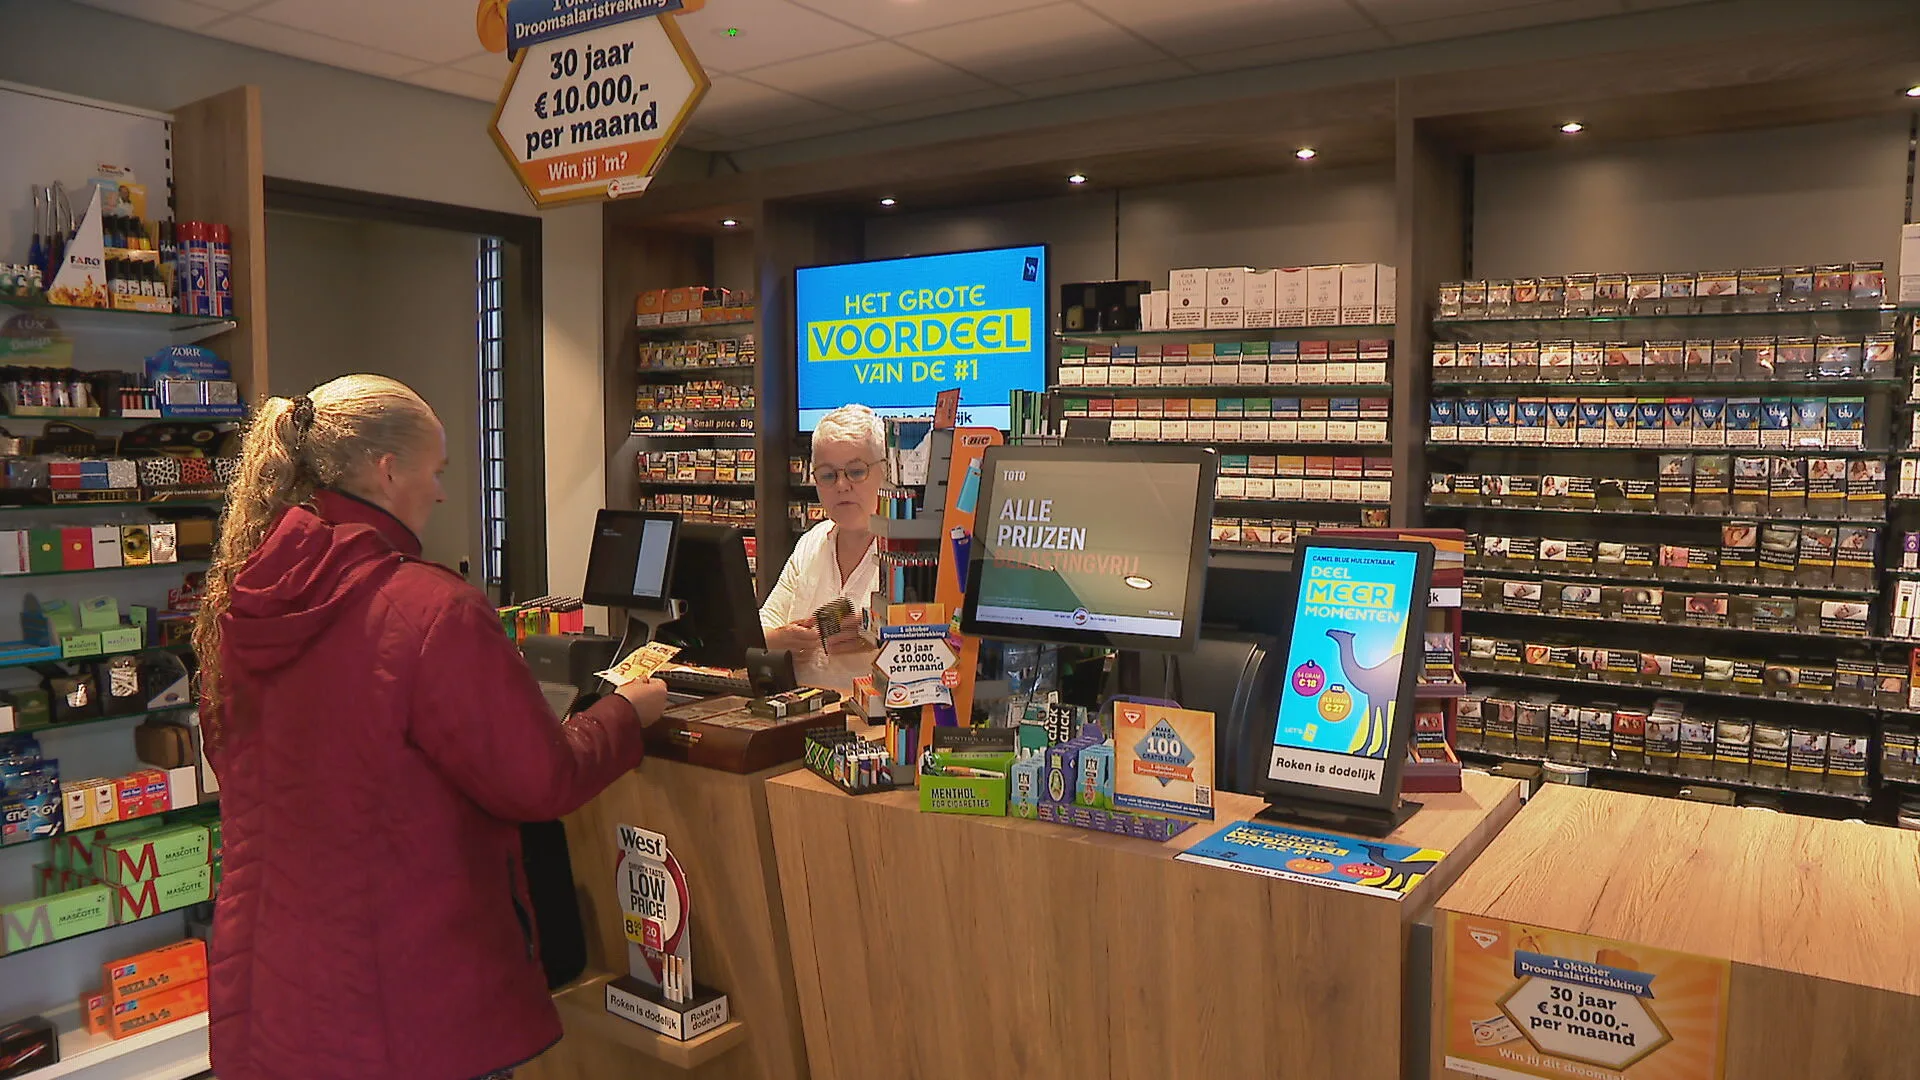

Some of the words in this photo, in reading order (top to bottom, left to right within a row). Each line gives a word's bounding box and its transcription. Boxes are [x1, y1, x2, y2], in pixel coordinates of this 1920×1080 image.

[550, 49, 578, 80] 30
[583, 41, 634, 80] jaar
[526, 126, 563, 160] per
[571, 101, 658, 145] maand
[548, 161, 578, 181] Win
[580, 156, 597, 181] jij
[70, 255, 100, 265] FARO
[844, 292, 891, 315] HET
[899, 284, 986, 311] GROTE
[811, 314, 1027, 357] VOORDEEL
[172, 347, 200, 356] ZORR
[853, 361, 903, 384] VAN
[912, 360, 946, 382] DE
[954, 359, 978, 381] #1
[1438, 407, 1450, 416] blu
[1467, 407, 1479, 417] blu
[1496, 407, 1508, 417] blu
[1525, 408, 1537, 417] blu
[1556, 409, 1568, 418] blu
[1586, 407, 1598, 416] blu
[1615, 408, 1627, 418] blu
[1644, 407, 1657, 416] blu
[1672, 408, 1685, 416] blu
[1702, 409, 1716, 418] blu
[1737, 409, 1749, 418] blu
[1769, 408, 1782, 416] blu
[1801, 409, 1815, 417] blu
[1838, 409, 1853, 418] blu
[694, 419, 714, 428] Small
[716, 419, 738, 429] price.
[741, 419, 753, 429] Big
[1003, 470, 1026, 481] TOTO
[1000, 499, 1053, 522] ALLE
[997, 525, 1087, 550] PRIJZEN
[1311, 566, 1352, 579] DEEL
[1310, 582, 1388, 605] MEER
[1305, 605, 1400, 623] MOMENTEN
[899, 644, 911, 652] 30
[913, 643, 934, 653] jaar
[890, 665, 907, 674] per
[909, 662, 944, 671] maand
[1049, 708, 1059, 741] CLICK
[1060, 709, 1070, 742] CLICK
[1147, 737, 1181, 757] 100
[1276, 757, 1312, 772] Roken
[1315, 760, 1325, 773] is
[1328, 764, 1376, 781] dodelijk
[947, 799, 990, 808] CIGARETTES
[620, 827, 662, 856] West
[165, 847, 200, 860] MASCOTTE
[119, 843, 161, 882] M
[166, 881, 201, 896] MASCOTTE
[629, 870, 665, 902] LOW
[119, 880, 161, 919] M
[631, 895, 667, 920] PRICE!
[58, 907, 100, 923] MASCOTTE
[646, 925, 657, 937] 20
[1553, 960, 1559, 969] 1
[1564, 961, 1610, 977] oktober
[1520, 961, 1643, 994] Droomsalaristrekking
[1550, 986, 1573, 1001] 30
[1577, 991, 1617, 1010] jaar
[610, 994, 635, 1012] Roken
[636, 1004, 643, 1016] is
[644, 1007, 677, 1029] dodelijk
[690, 1007, 713, 1022] Roken
[714, 1003, 722, 1013] is
[692, 1013, 721, 1030] dodelijk
[1530, 1015, 1562, 1030] per
[1567, 1023, 1636, 1047] maand
[1498, 1047, 1524, 1061] Win
[1527, 1055, 1542, 1067] jij
[1543, 1058, 1563, 1071] dit
